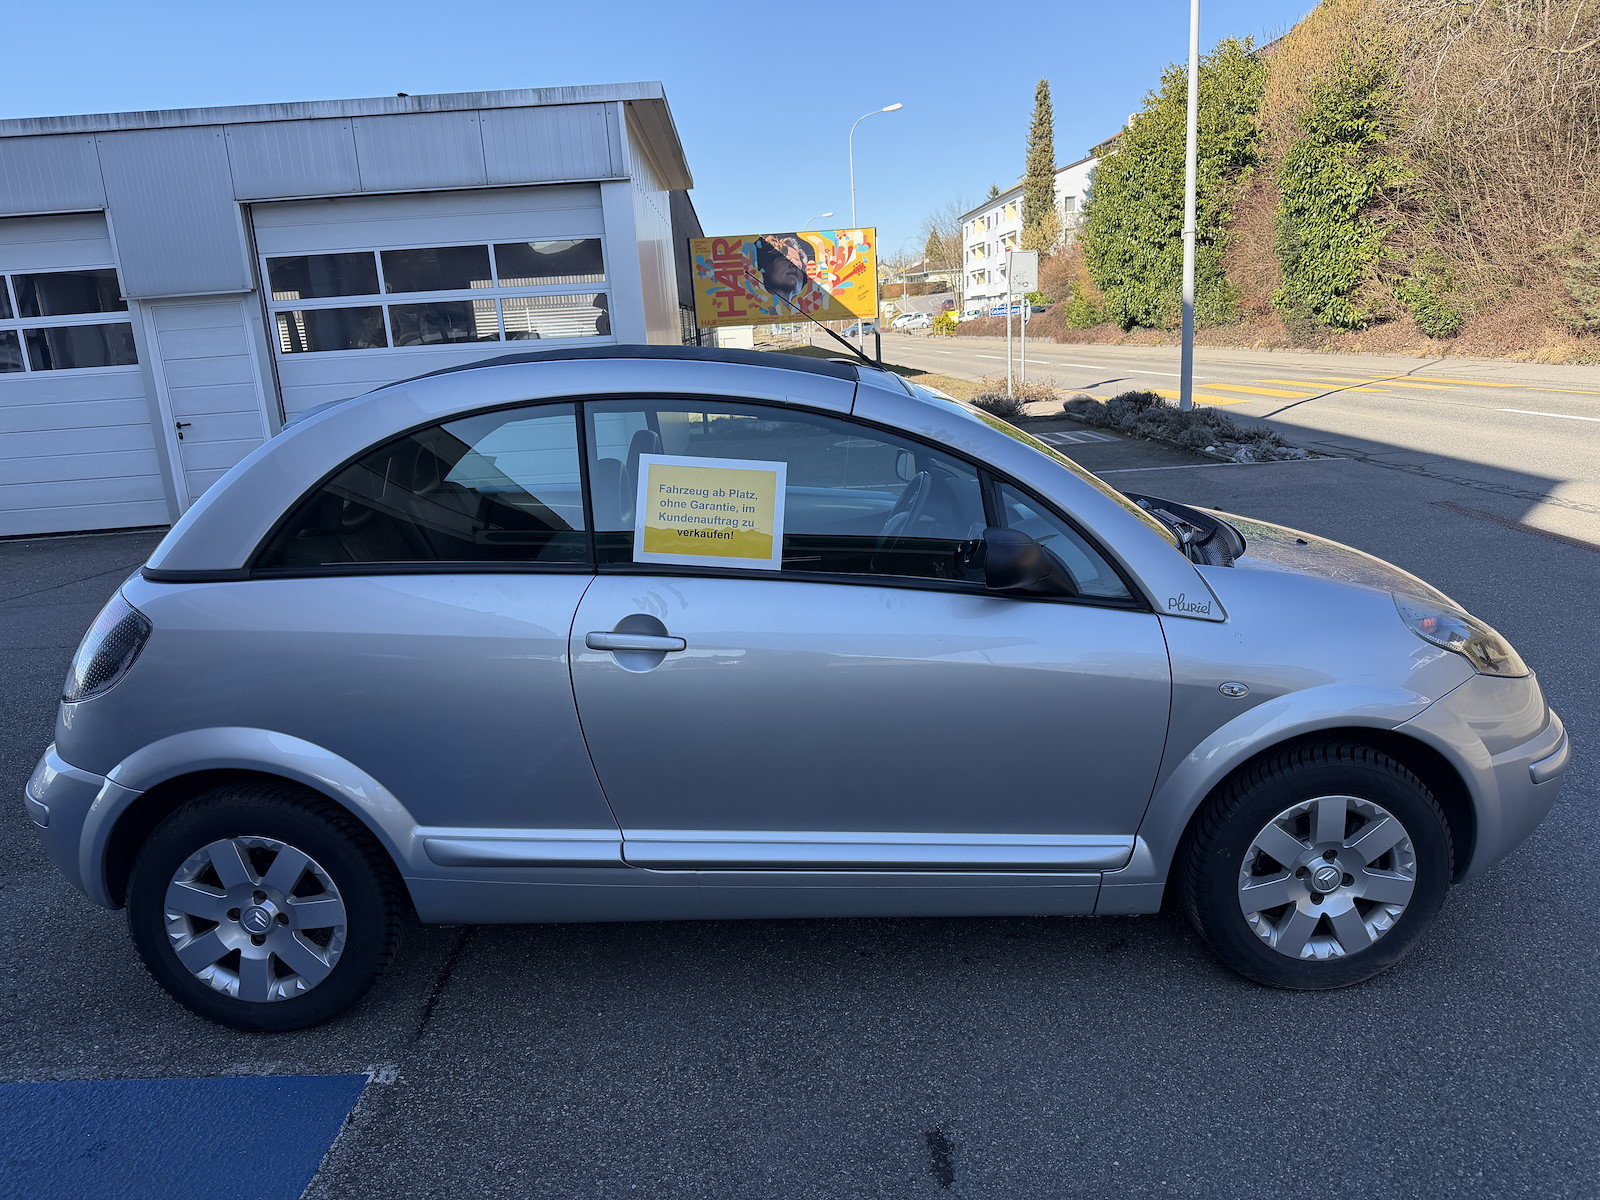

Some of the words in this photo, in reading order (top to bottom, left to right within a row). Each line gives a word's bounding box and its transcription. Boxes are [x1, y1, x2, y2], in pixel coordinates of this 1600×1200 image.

[712, 238, 747, 318] HAIR
[701, 319, 718, 327] HAIR
[659, 484, 709, 498] Fahrzeug
[712, 488, 726, 498] ab
[728, 488, 758, 500] Platz,
[659, 498, 687, 509] ohne
[690, 500, 739, 513] Garantie,
[742, 503, 755, 513] im
[658, 511, 739, 528] Kundenauftrag
[741, 519, 755, 528] zu
[676, 528, 734, 540] verkaufen!
